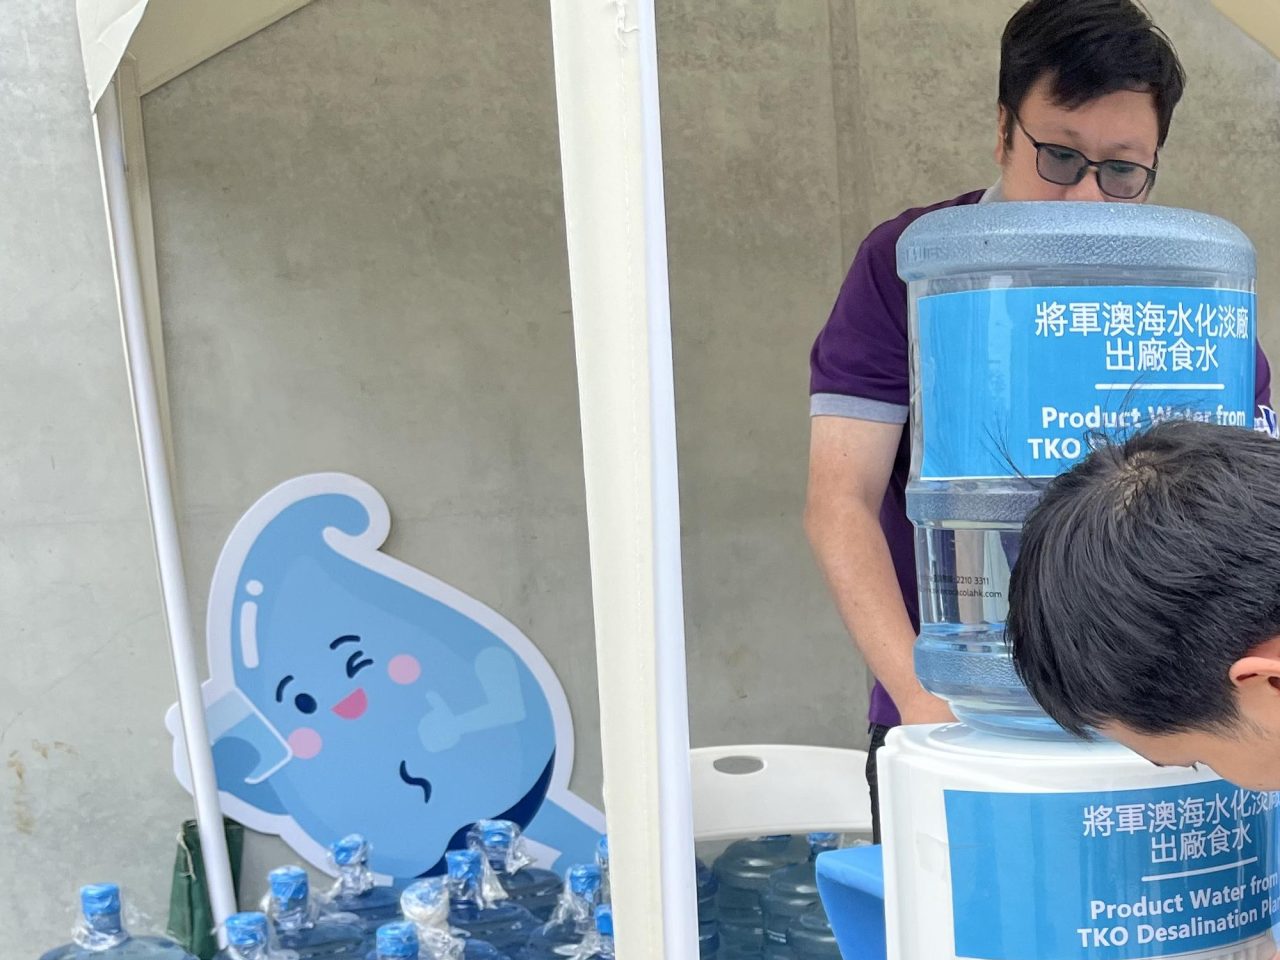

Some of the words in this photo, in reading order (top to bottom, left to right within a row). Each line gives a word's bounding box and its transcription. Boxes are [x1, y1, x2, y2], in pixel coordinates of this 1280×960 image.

[1035, 301, 1248, 340] 將軍澳海水化淡廠
[1105, 338, 1219, 372] 出廠食水
[1042, 406, 1142, 429] Product
[1217, 404, 1246, 427] from
[1027, 438, 1081, 460] TKO
[1151, 823, 1252, 864] 出廠食水
[1090, 892, 1184, 920] Product
[1189, 883, 1247, 911] Water
[1250, 871, 1278, 897] from
[1077, 925, 1129, 948] TKO
[1137, 906, 1258, 945] Desalination
